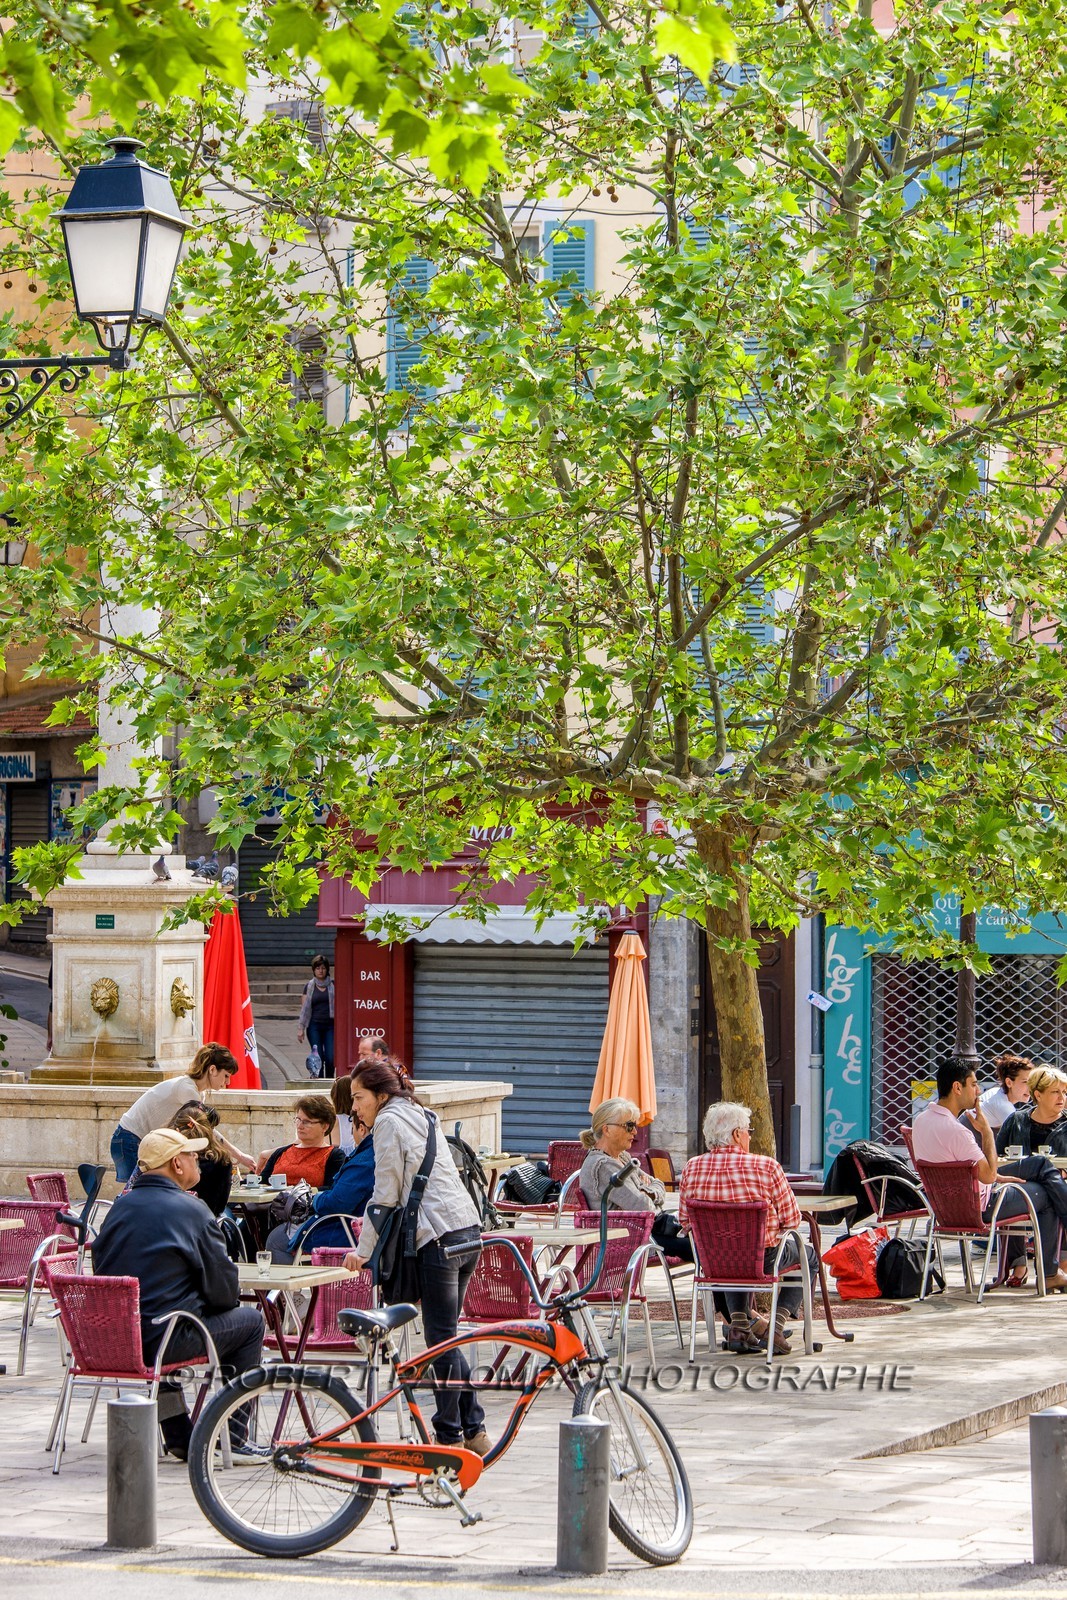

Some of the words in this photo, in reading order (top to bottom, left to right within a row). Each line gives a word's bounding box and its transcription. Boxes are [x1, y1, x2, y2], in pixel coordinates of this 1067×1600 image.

[360, 970, 381, 981] BAR
[353, 999, 387, 1010] TABAC
[355, 1027, 386, 1038] LOTO
